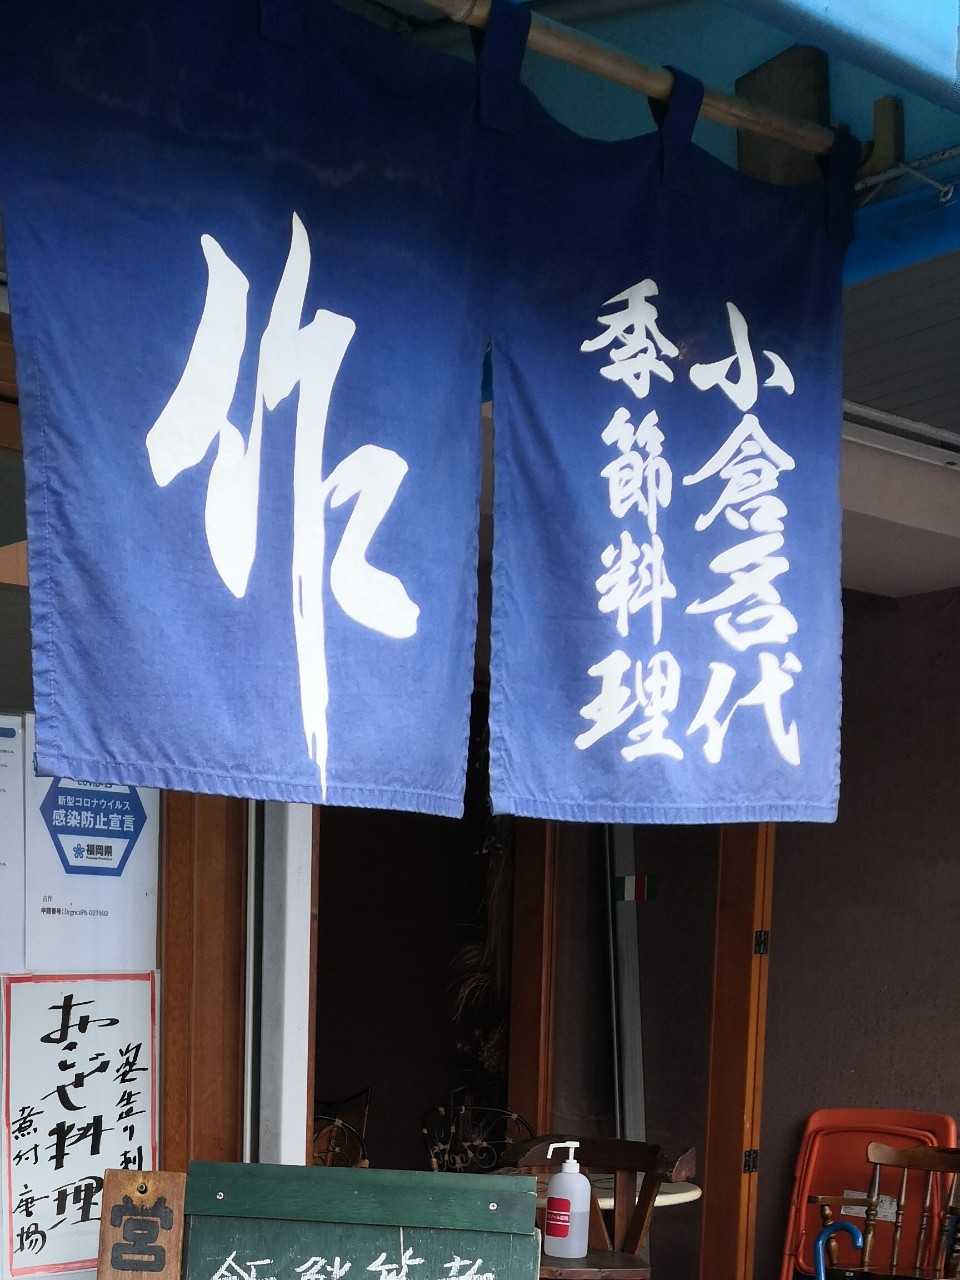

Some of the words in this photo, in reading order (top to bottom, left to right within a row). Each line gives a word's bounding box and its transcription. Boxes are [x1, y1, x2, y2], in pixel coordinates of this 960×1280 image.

[574, 278, 684, 763] 季節料理
[57, 795, 131, 811] 新型コロナウイルス
[52, 810, 135, 832] 感染防止宣言
